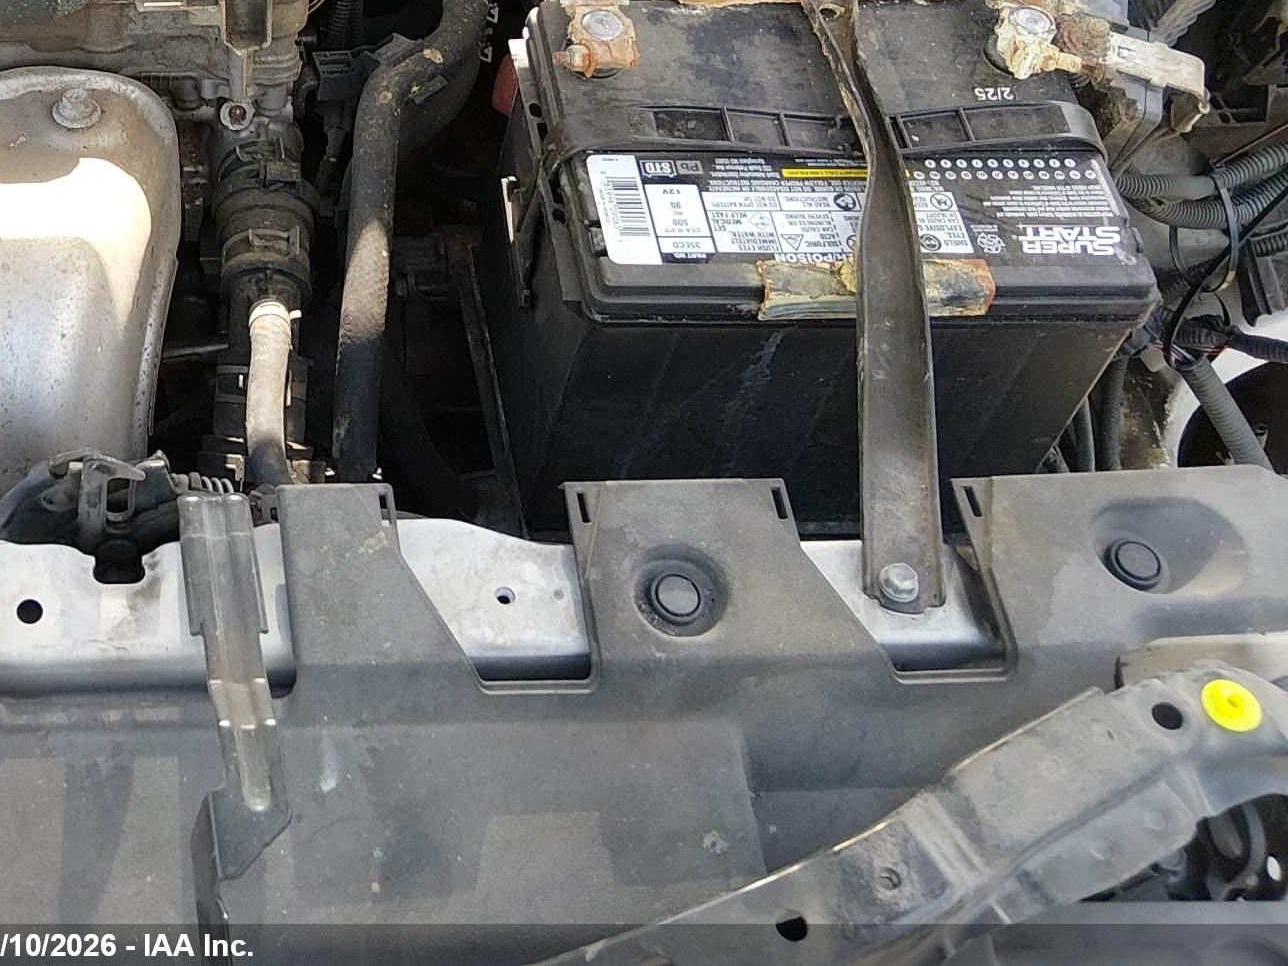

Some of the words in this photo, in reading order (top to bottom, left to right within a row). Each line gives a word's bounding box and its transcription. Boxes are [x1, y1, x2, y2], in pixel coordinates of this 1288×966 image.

[974, 87, 1014, 101] 2/25
[645, 162, 672, 174] STD
[681, 162, 699, 172] Pb
[672, 218, 689, 226] 500
[924, 224, 962, 232] EXPLOSIVE
[1018, 225, 1121, 243] START
[757, 244, 779, 252] FLUSH
[1022, 240, 1115, 256] SUPER
